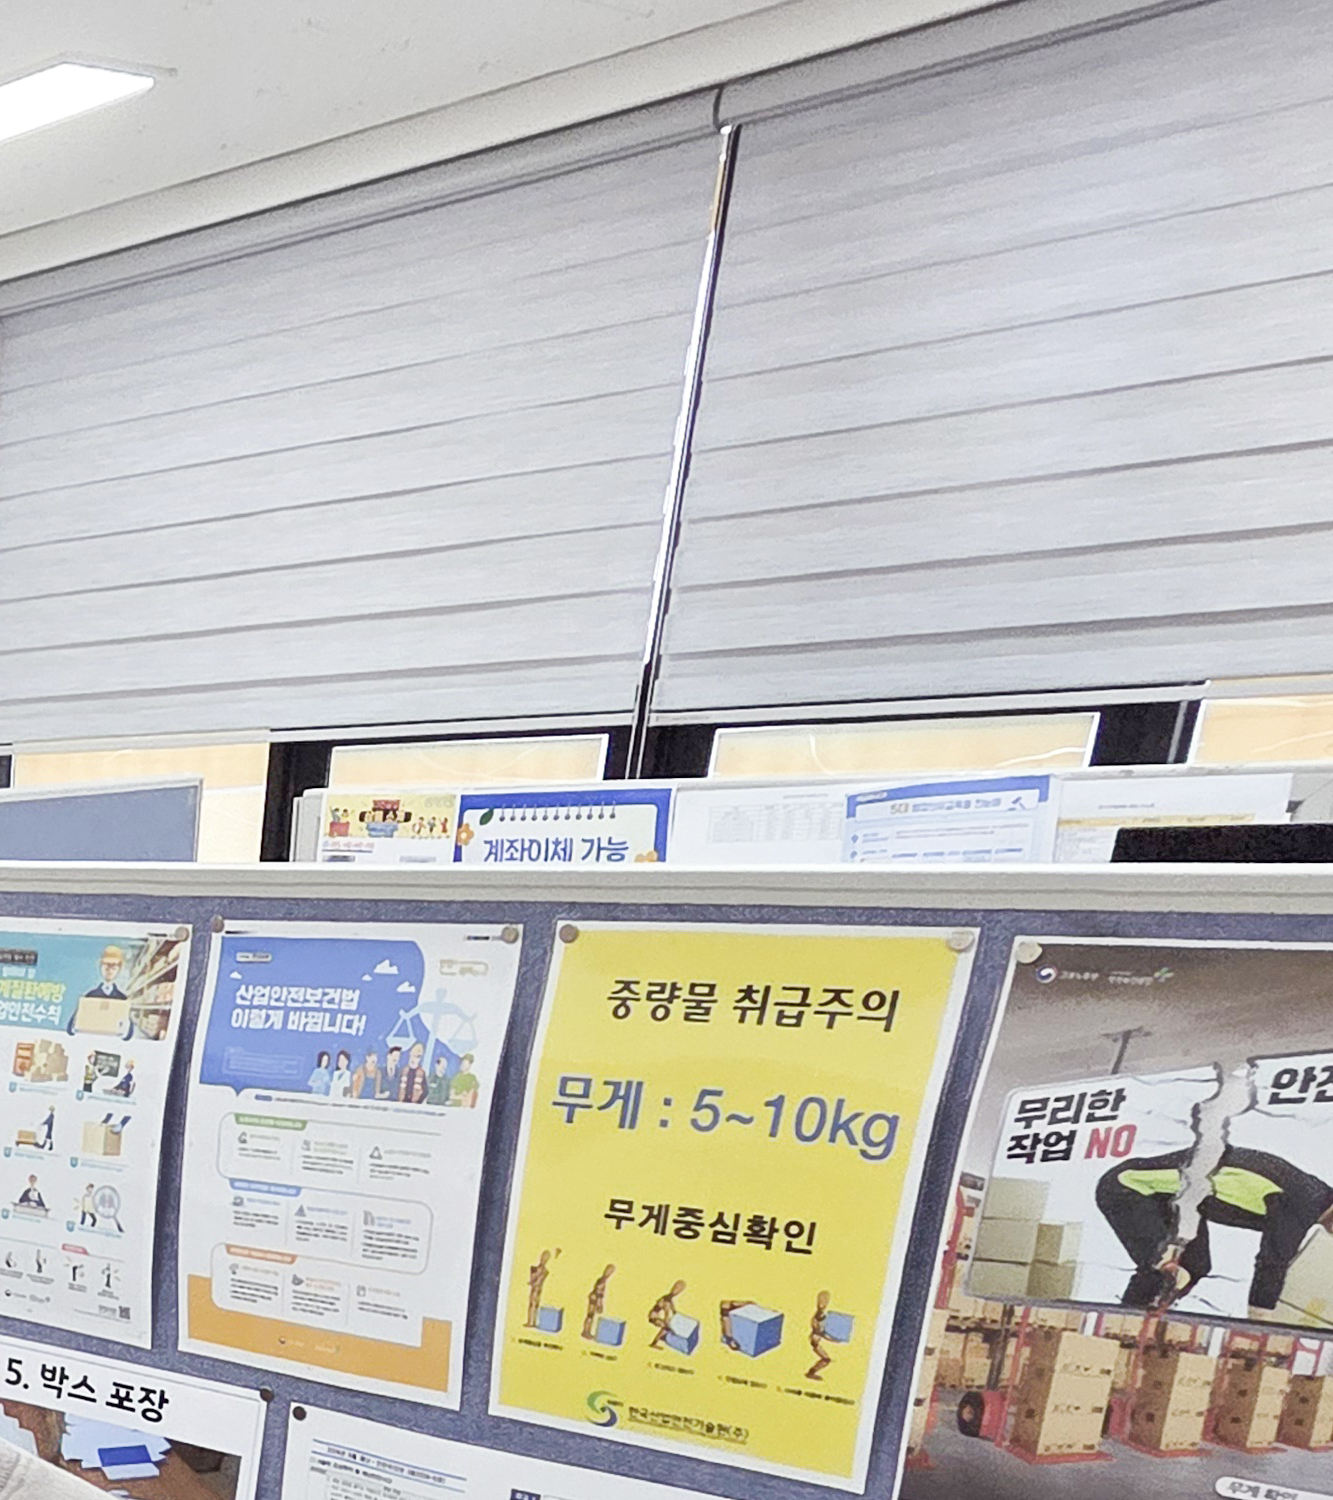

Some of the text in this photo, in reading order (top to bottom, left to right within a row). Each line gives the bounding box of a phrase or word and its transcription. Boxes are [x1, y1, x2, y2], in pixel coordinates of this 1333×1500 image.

[483, 837, 630, 863] 계좌이체 가능
[235, 984, 361, 1011] 산업안전보건법
[607, 979, 900, 1033] 중량물 취급주의
[231, 1008, 283, 1030] 이렇게
[552, 1075, 644, 1130] 무게
[689, 1087, 900, 1161] 5~10kg
[1014, 1087, 1126, 1129] 무리한
[1007, 1124, 1137, 1164] 작업 NO
[604, 1198, 817, 1255] 무게중심확인
[5, 1357, 170, 1424] 5. 박스 포장
